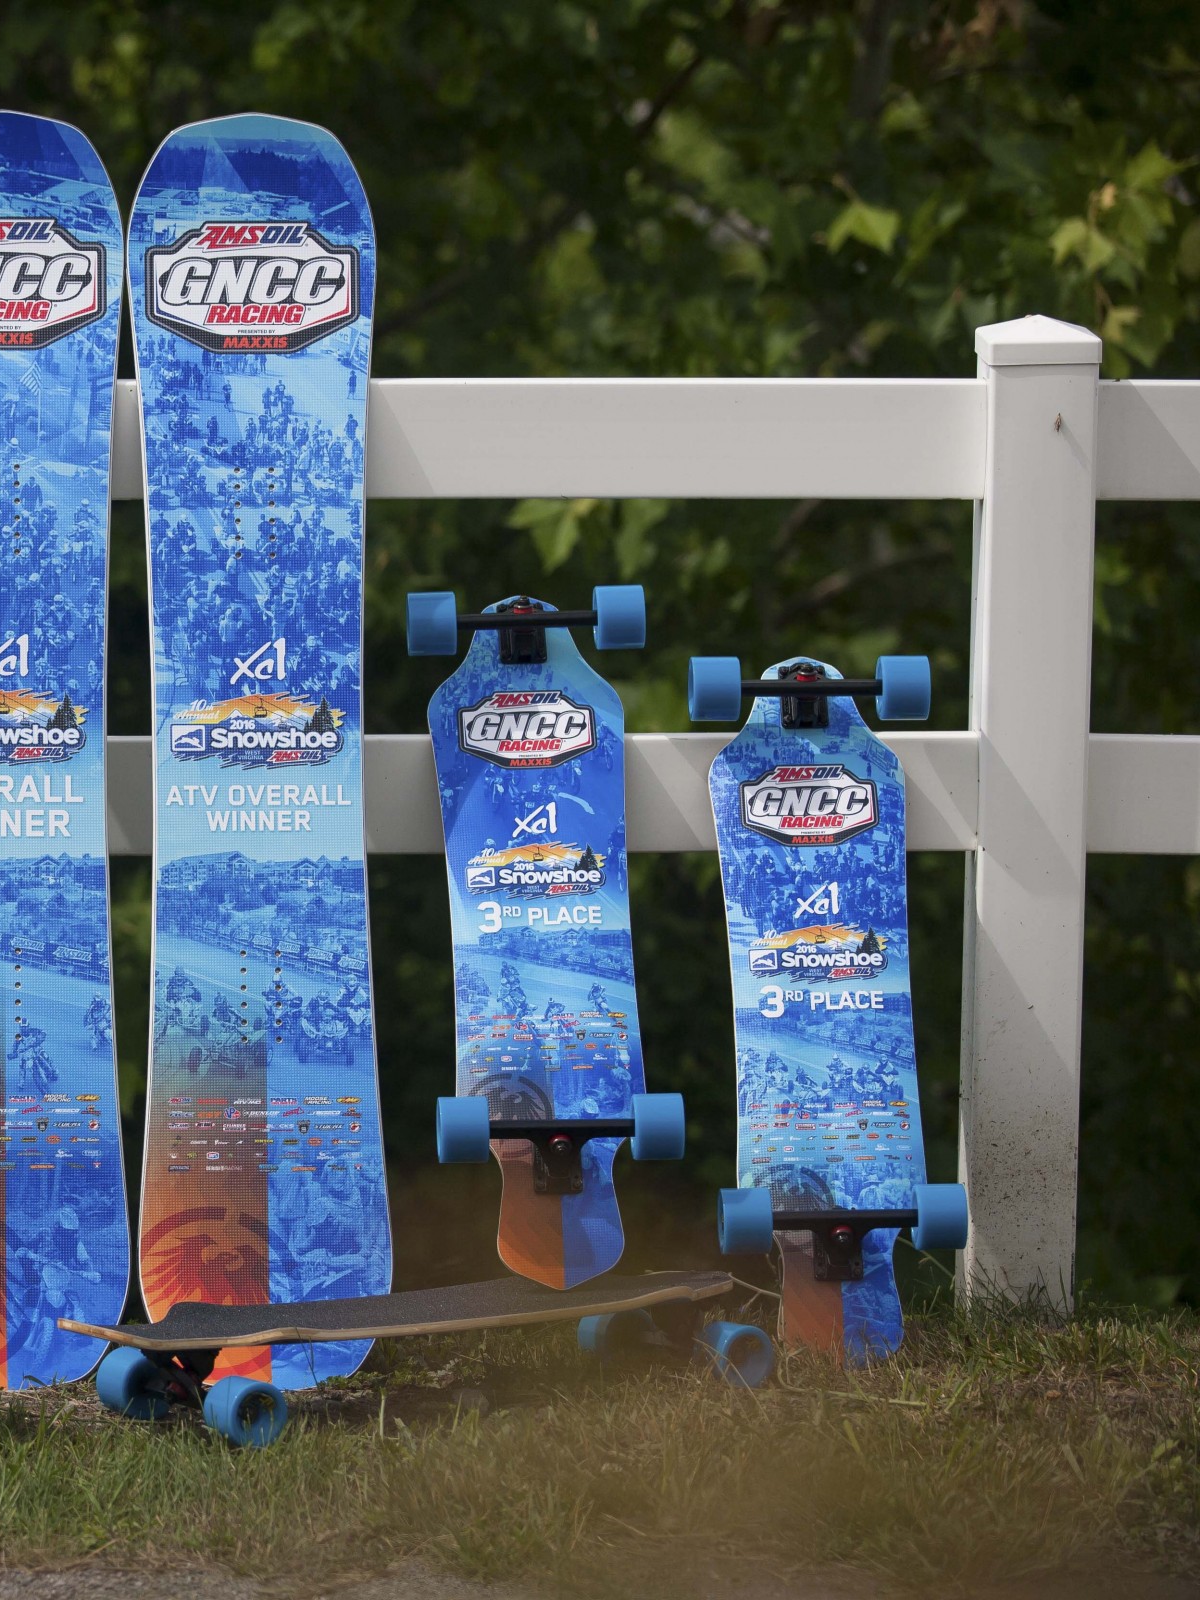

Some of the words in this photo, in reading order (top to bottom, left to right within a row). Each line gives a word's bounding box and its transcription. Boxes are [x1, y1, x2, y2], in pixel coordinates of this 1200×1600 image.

[196, 226, 304, 249] AMSOIL
[161, 257, 344, 305] GNCC
[206, 304, 304, 324] RACING
[223, 336, 288, 349] MAXXIS
[489, 691, 561, 707] AMSOIL
[230, 719, 256, 730] 2016
[468, 710, 587, 741] GNCC
[211, 728, 339, 748] Snowshoe
[9, 747, 64, 758] AMSOIL
[498, 740, 560, 753] RACING
[267, 750, 321, 763] AMSOIL
[509, 757, 552, 767] MAXXIS
[775, 766, 842, 782] AMSOIL
[166, 785, 219, 806] ATV
[228, 784, 352, 806] OVERALL
[749, 785, 869, 817] GNCC
[207, 811, 309, 832] WINNER
[780, 815, 844, 830] RACING
[792, 835, 834, 844] MAXXIS
[513, 862, 535, 872] 2016
[499, 867, 601, 884] Snowshoe
[544, 883, 589, 894] AMSOIL
[477, 901, 522, 934] 3RD
[527, 905, 603, 925] PLACE
[795, 944, 817, 953] 2016
[782, 950, 884, 967] Snowshoe
[827, 967, 871, 977] AMSOIL
[760, 985, 804, 1018] 3RD
[810, 990, 885, 1010] PLACE
